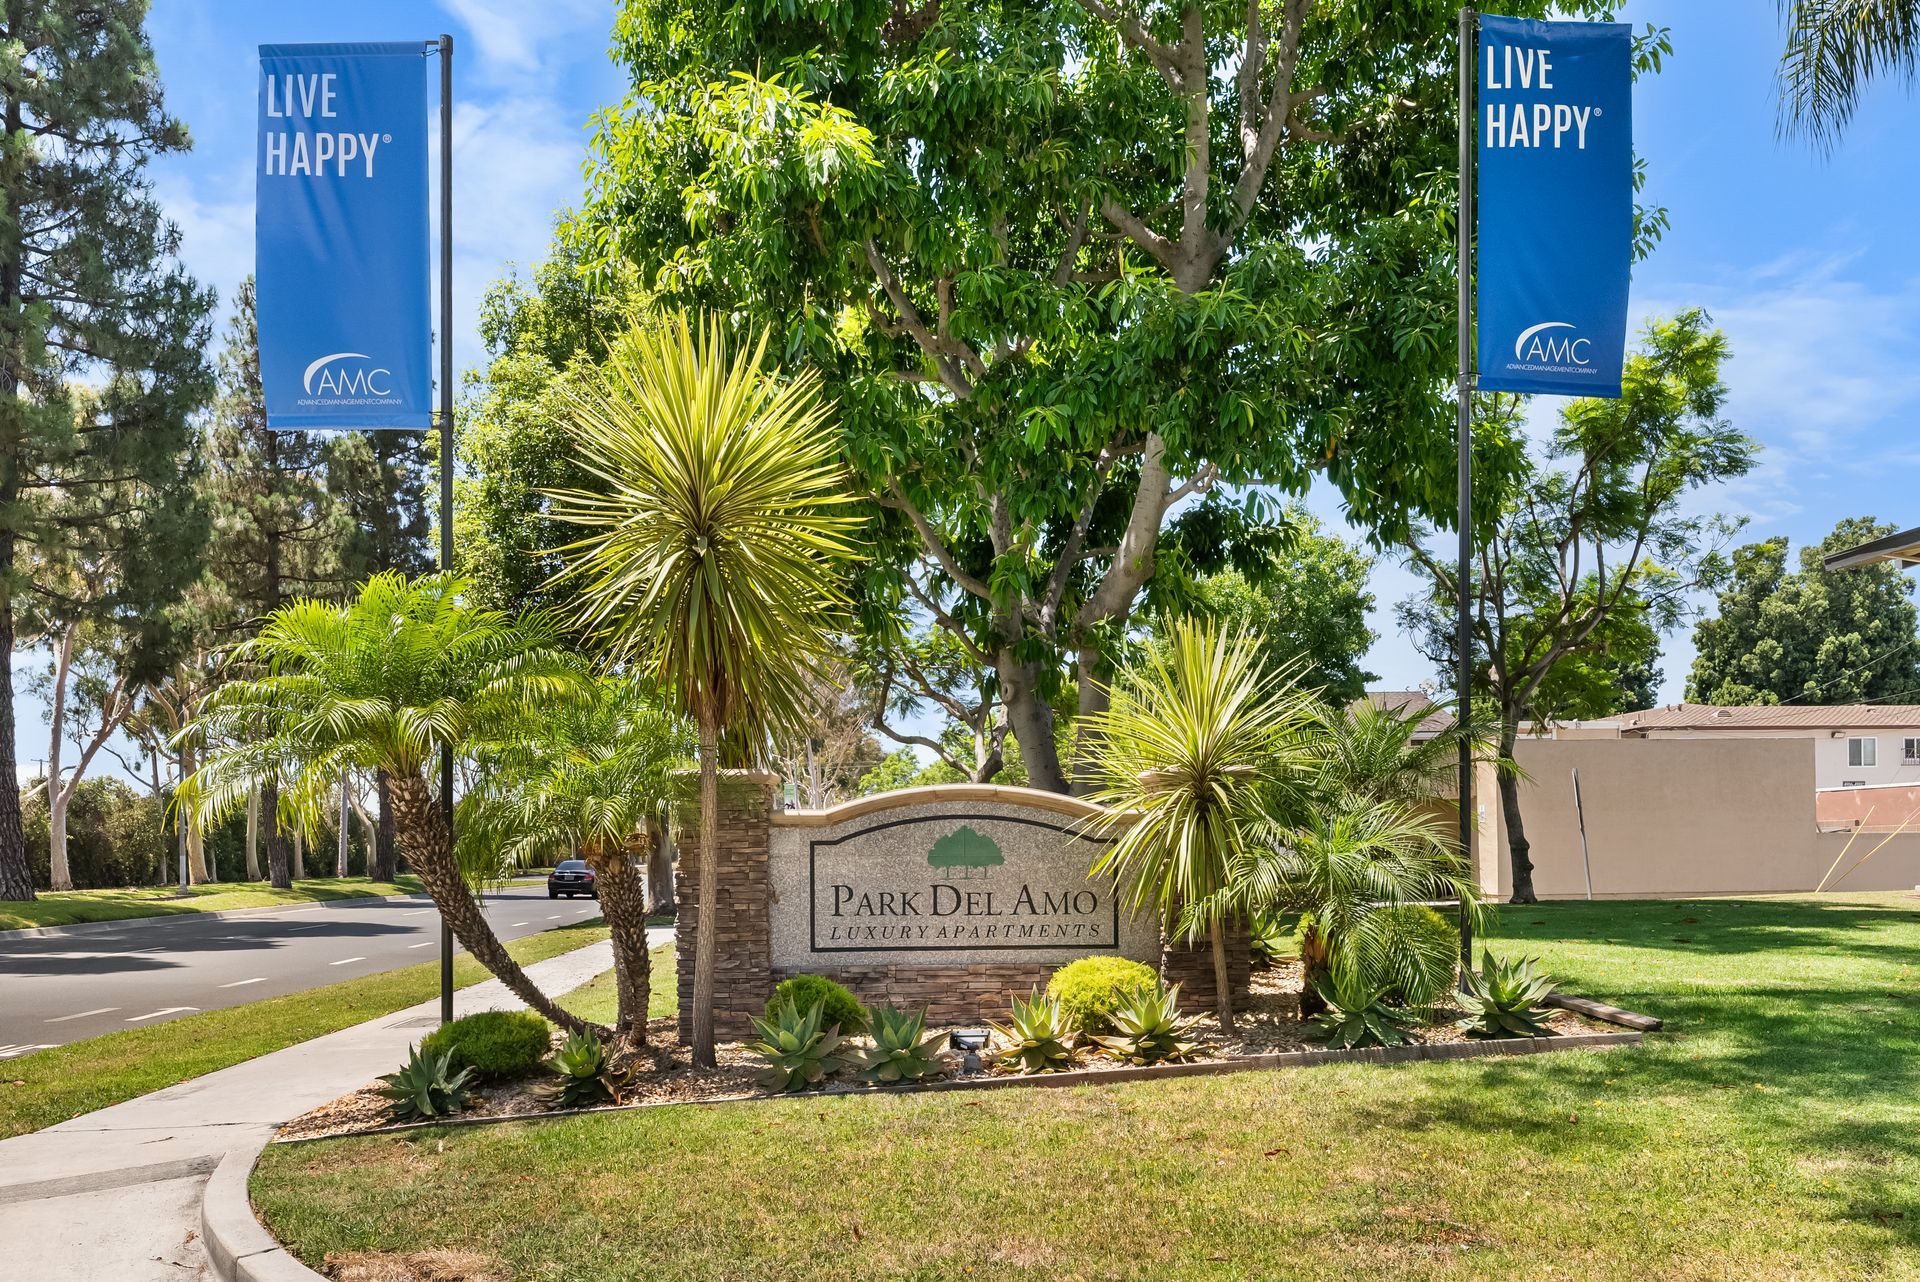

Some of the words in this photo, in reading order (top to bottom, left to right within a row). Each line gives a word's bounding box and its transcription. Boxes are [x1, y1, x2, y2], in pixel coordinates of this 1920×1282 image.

[1487, 45, 1553, 90] LIVE
[267, 74, 337, 118] LIVE
[1526, 336, 1591, 365] AMC
[317, 368, 391, 396] AMC
[831, 884, 922, 917] PARK
[930, 884, 1003, 917] DEL
[1009, 883, 1099, 917] AMO
[830, 925, 929, 940] LUXURY
[935, 923, 1101, 939] APARTMENTS
